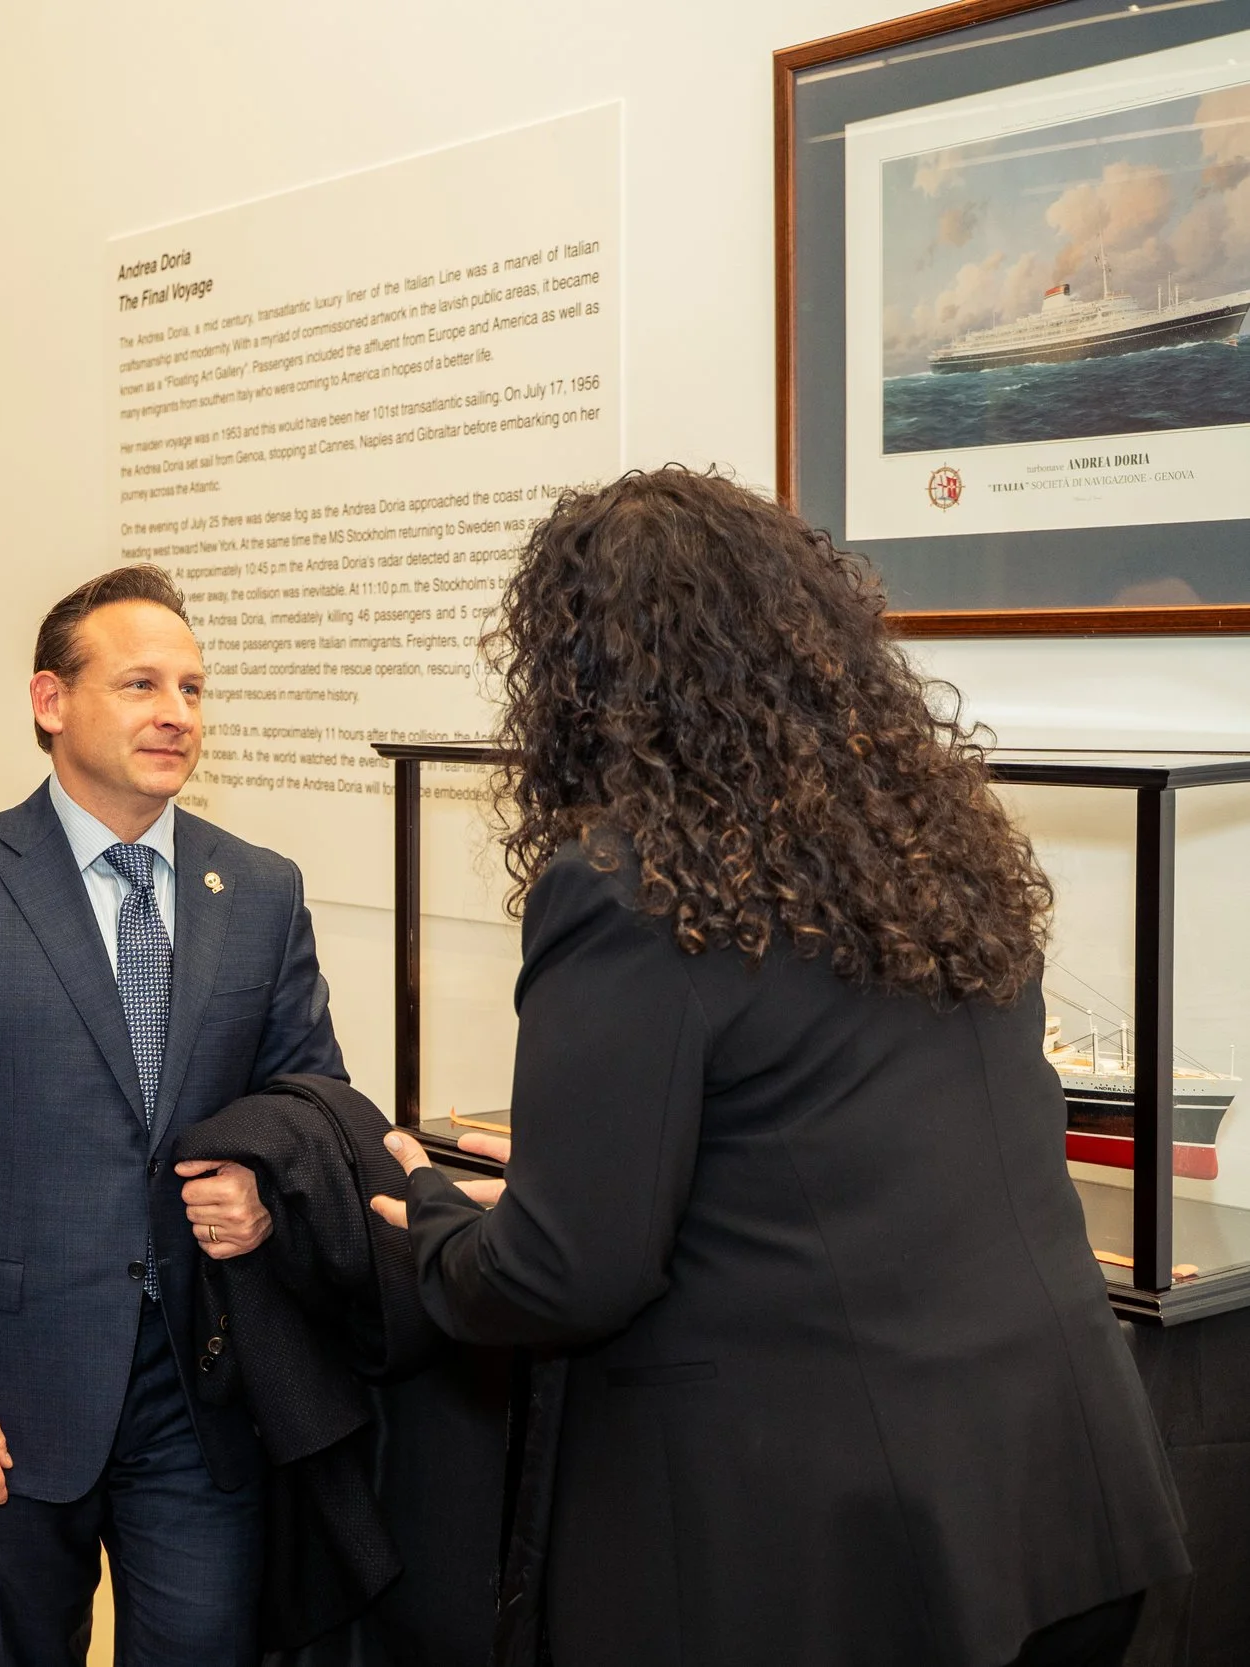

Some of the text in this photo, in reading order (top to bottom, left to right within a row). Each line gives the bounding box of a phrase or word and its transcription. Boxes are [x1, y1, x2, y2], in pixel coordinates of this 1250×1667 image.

[118, 250, 191, 280] Andrea Doria
[258, 240, 600, 321] transatlantic luxury liner of the Italian Line was a marvel of Italian
[119, 279, 213, 311] The Final Voyage
[232, 272, 600, 351] With commissioned artwork in the lavish public areas, it became
[305, 345, 344, 363] included
[346, 343, 361, 357] the
[364, 336, 400, 354] affluent
[402, 332, 425, 346] from
[428, 325, 466, 342] Europe
[469, 318, 489, 336] and
[492, 312, 538, 330] America
[541, 310, 555, 323] as
[559, 302, 582, 319] well
[585, 302, 600, 315] as
[330, 347, 494, 386] to America in hopes of a better life.
[221, 374, 600, 440] 1953 been her 101st transatlantic sailing. On July 17, 1956
[359, 433, 393, 448] Naples
[395, 429, 414, 444] and
[416, 424, 461, 441] Gibraltar
[463, 419, 497, 435] before
[500, 412, 560, 431] embarking
[562, 410, 577, 423] on
[580, 407, 600, 420] her
[1026, 452, 1150, 474] turbonave ANDREA DORIA
[1072, 477, 1082, 488] DI
[1084, 473, 1147, 487] NAVIGAZIONE
[1154, 469, 1195, 482] GENOVA
[121, 522, 134, 536] On
[190, 517, 207, 532] July
[209, 514, 220, 528] 25
[222, 514, 243, 527] there
[311, 507, 322, 519] as
[324, 504, 339, 518] the
[342, 502, 376, 516] Andrea
[379, 498, 405, 513] Doria
[409, 493, 469, 512] approached
[473, 491, 489, 504] the
[493, 488, 523, 503] coast
[526, 484, 538, 500] of
[200, 540, 218, 553] New
[313, 532, 327, 545] the
[329, 528, 344, 544] MS
[347, 527, 397, 543] Stockholm
[399, 524, 443, 540] returning
[446, 522, 455, 535] to
[458, 519, 501, 535] Sweden
[503, 518, 525, 531] was
[306, 558, 339, 571] Andrea
[342, 555, 375, 569] Doria's
[377, 553, 403, 567] radar
[406, 550, 450, 566] detected
[453, 551, 466, 563] an
[349, 582, 360, 595] At
[362, 580, 388, 594] 11:10
[414, 579, 430, 592] the
[433, 577, 495, 592] Stockholm's
[327, 609, 354, 626] killing
[358, 607, 370, 622] 46
[374, 608, 431, 624] passengers
[436, 606, 456, 620] and
[460, 604, 467, 619] 5
[318, 636, 347, 649] Italian
[406, 633, 460, 651] Freighters,
[323, 662, 338, 675] the
[340, 663, 371, 675] rescue
[427, 663, 471, 679] rescuing
[338, 727, 366, 739] hours
[367, 726, 388, 741] after
[391, 729, 406, 742] the
[300, 752, 355, 766] watched the
[303, 776, 335, 791] Andrea
[338, 778, 363, 792] Doria
[365, 780, 380, 793] will
[434, 782, 487, 799] embedded
